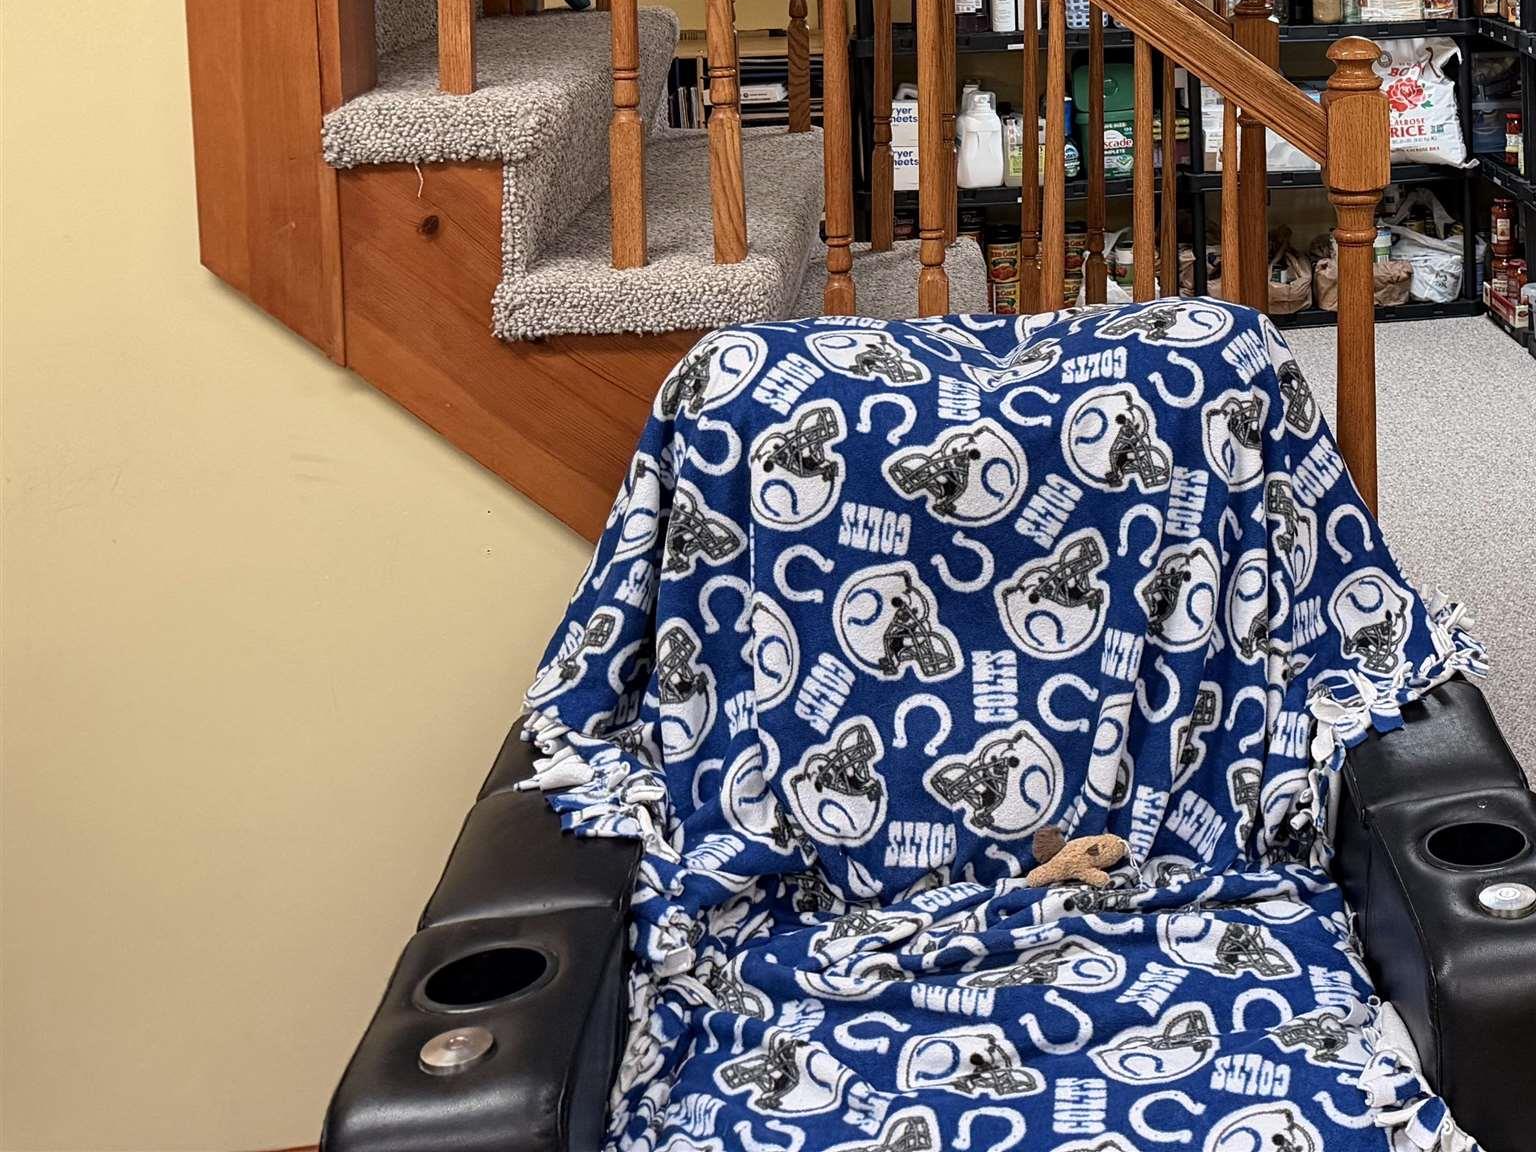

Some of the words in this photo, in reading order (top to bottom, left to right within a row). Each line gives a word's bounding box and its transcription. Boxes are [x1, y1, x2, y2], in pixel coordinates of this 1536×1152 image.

[892, 113, 919, 124] heets
[894, 106, 912, 117] ryer
[1390, 126, 1427, 139] RICE
[1391, 117, 1425, 127] ALROSE
[893, 156, 919, 167] heets
[894, 150, 913, 160] ryer
[1104, 137, 1134, 148] scade
[752, 352, 825, 412] COLTS
[1061, 346, 1128, 386] COLTS
[1293, 438, 1344, 508] COLTS
[839, 501, 912, 556] COLTS
[1014, 473, 1084, 549] COLTS
[1165, 465, 1209, 539] COLTS
[795, 651, 857, 736] COLTS
[972, 648, 1018, 724] COLTS
[885, 820, 958, 869] COLTS
[1128, 784, 1170, 864] COLTS
[1165, 789, 1229, 863] COLTS
[1116, 961, 1190, 1018] COLTS
[1210, 1053, 1293, 1098] COLTS
[1052, 1077, 1109, 1136] COLTS
